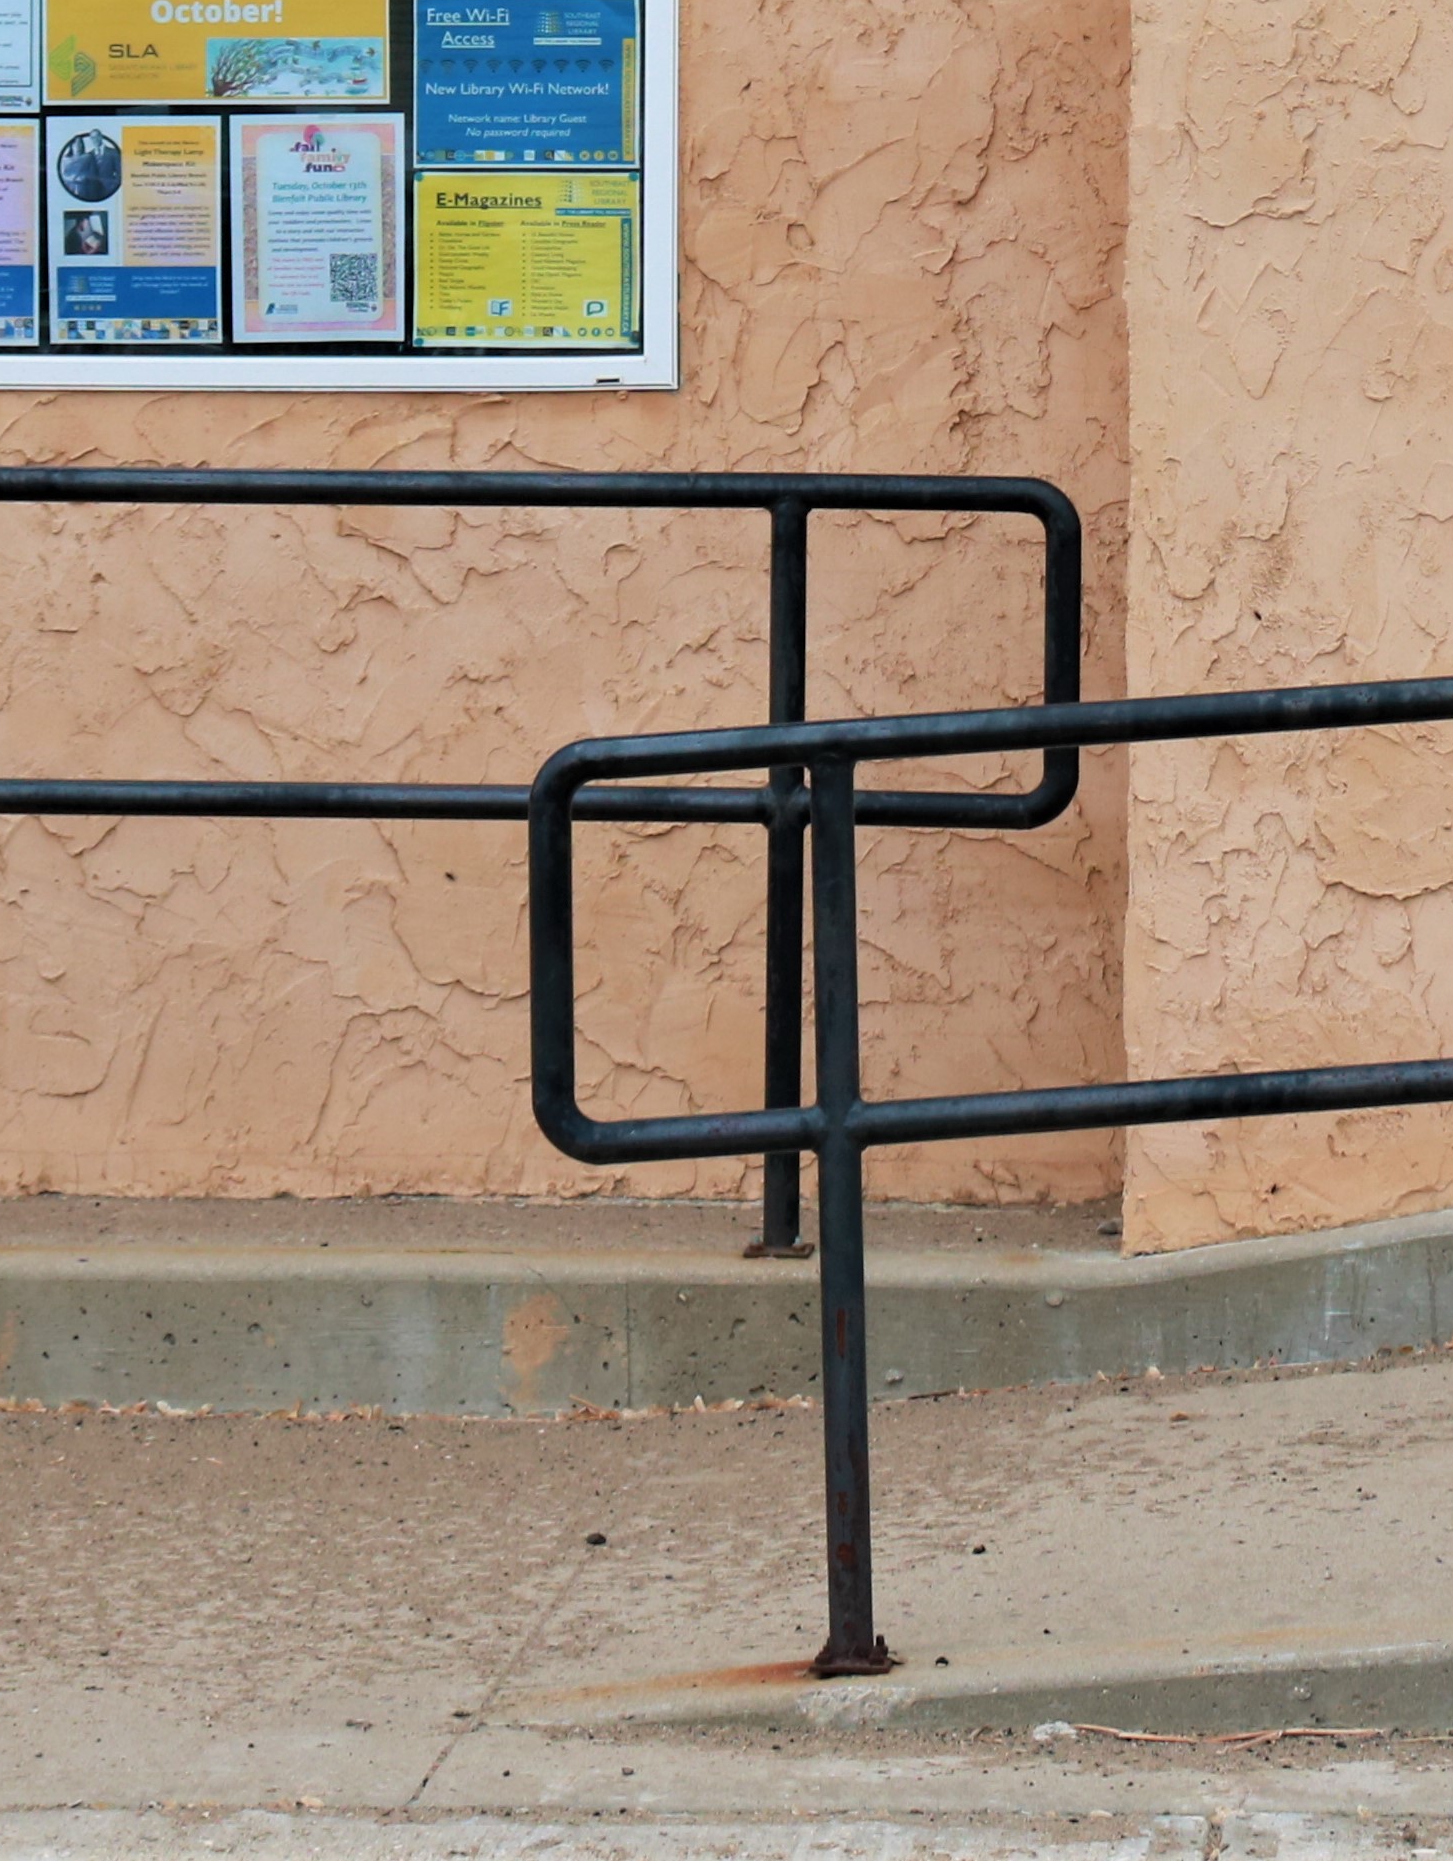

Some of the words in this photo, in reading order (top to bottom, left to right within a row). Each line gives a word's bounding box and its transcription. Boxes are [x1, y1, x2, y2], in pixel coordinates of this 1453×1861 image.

[151, 0, 283, 23] October!
[427, 8, 461, 23] Free
[466, 8, 509, 23] Wi-Fi
[442, 31, 495, 46] Access
[109, 44, 159, 58] SLA
[426, 83, 455, 95] New
[460, 83, 504, 97] Library
[509, 83, 544, 94] Wi-Fi
[548, 83, 609, 95] Network!
[448, 114, 490, 123] Network
[524, 114, 555, 124] Library
[560, 114, 586, 123] Guest
[466, 128, 481, 136] No
[484, 128, 528, 138] password
[531, 128, 570, 138] required
[273, 182, 309, 191] Tuesday,
[312, 182, 346, 190] October
[309, 194, 334, 203] Public
[337, 194, 366, 204] Library
[436, 193, 542, 208] E-Magazines
